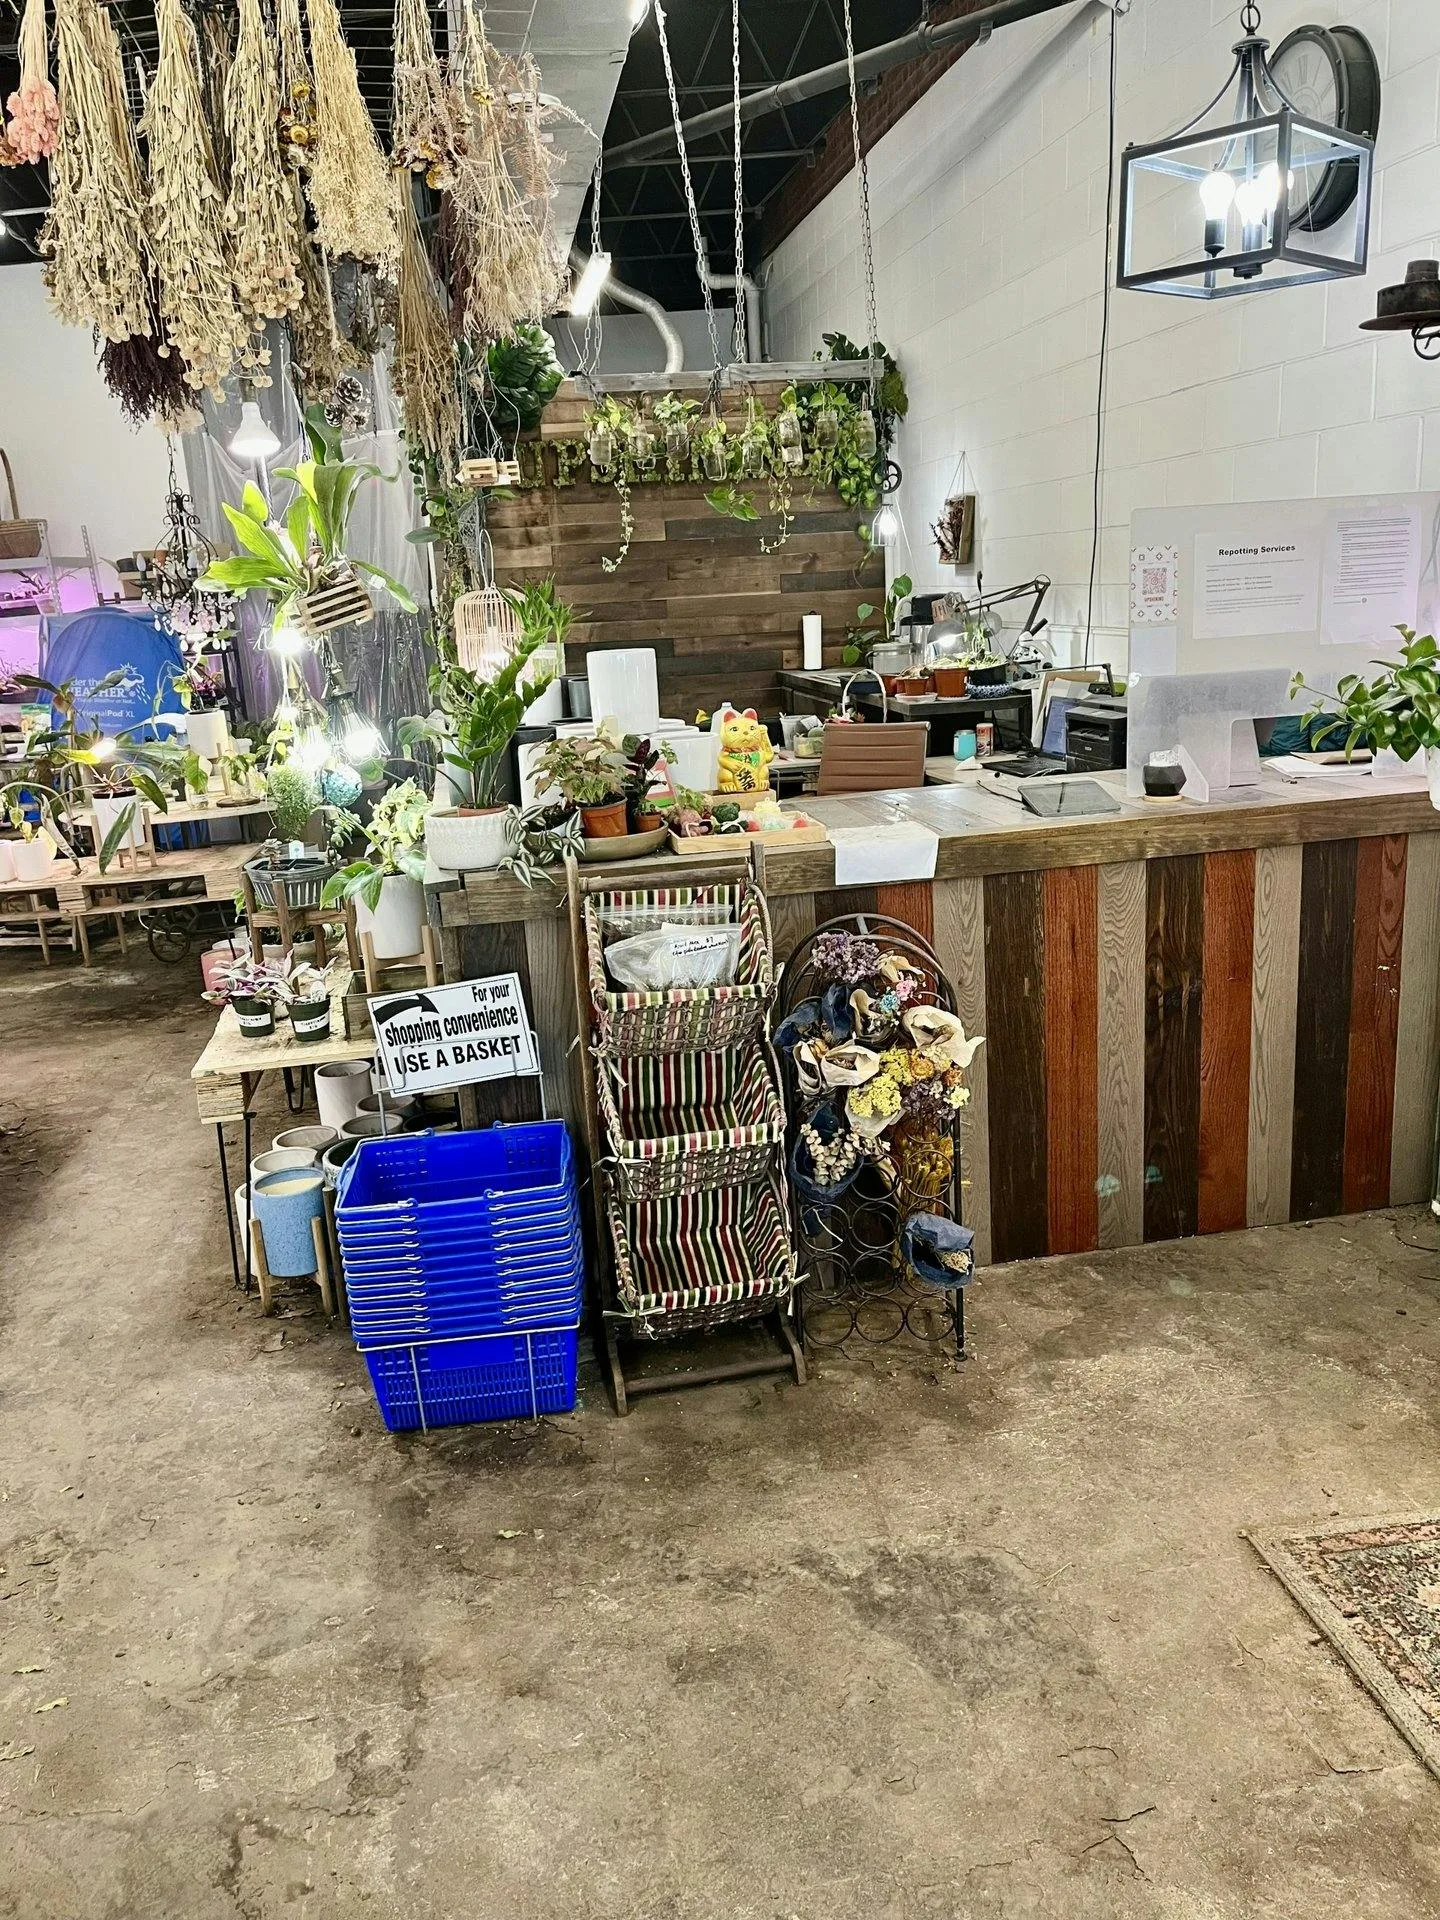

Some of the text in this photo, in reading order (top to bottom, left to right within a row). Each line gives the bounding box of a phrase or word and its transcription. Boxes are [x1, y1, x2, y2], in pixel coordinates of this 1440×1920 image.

[1218, 545, 1296, 557] Repotting Services
[66, 687, 127, 698] EAHER
[125, 710, 135, 718] XL
[471, 983, 510, 1003] For your
[385, 1005, 519, 1049] shopping convenience
[394, 1035, 521, 1075] USE A BASKET
